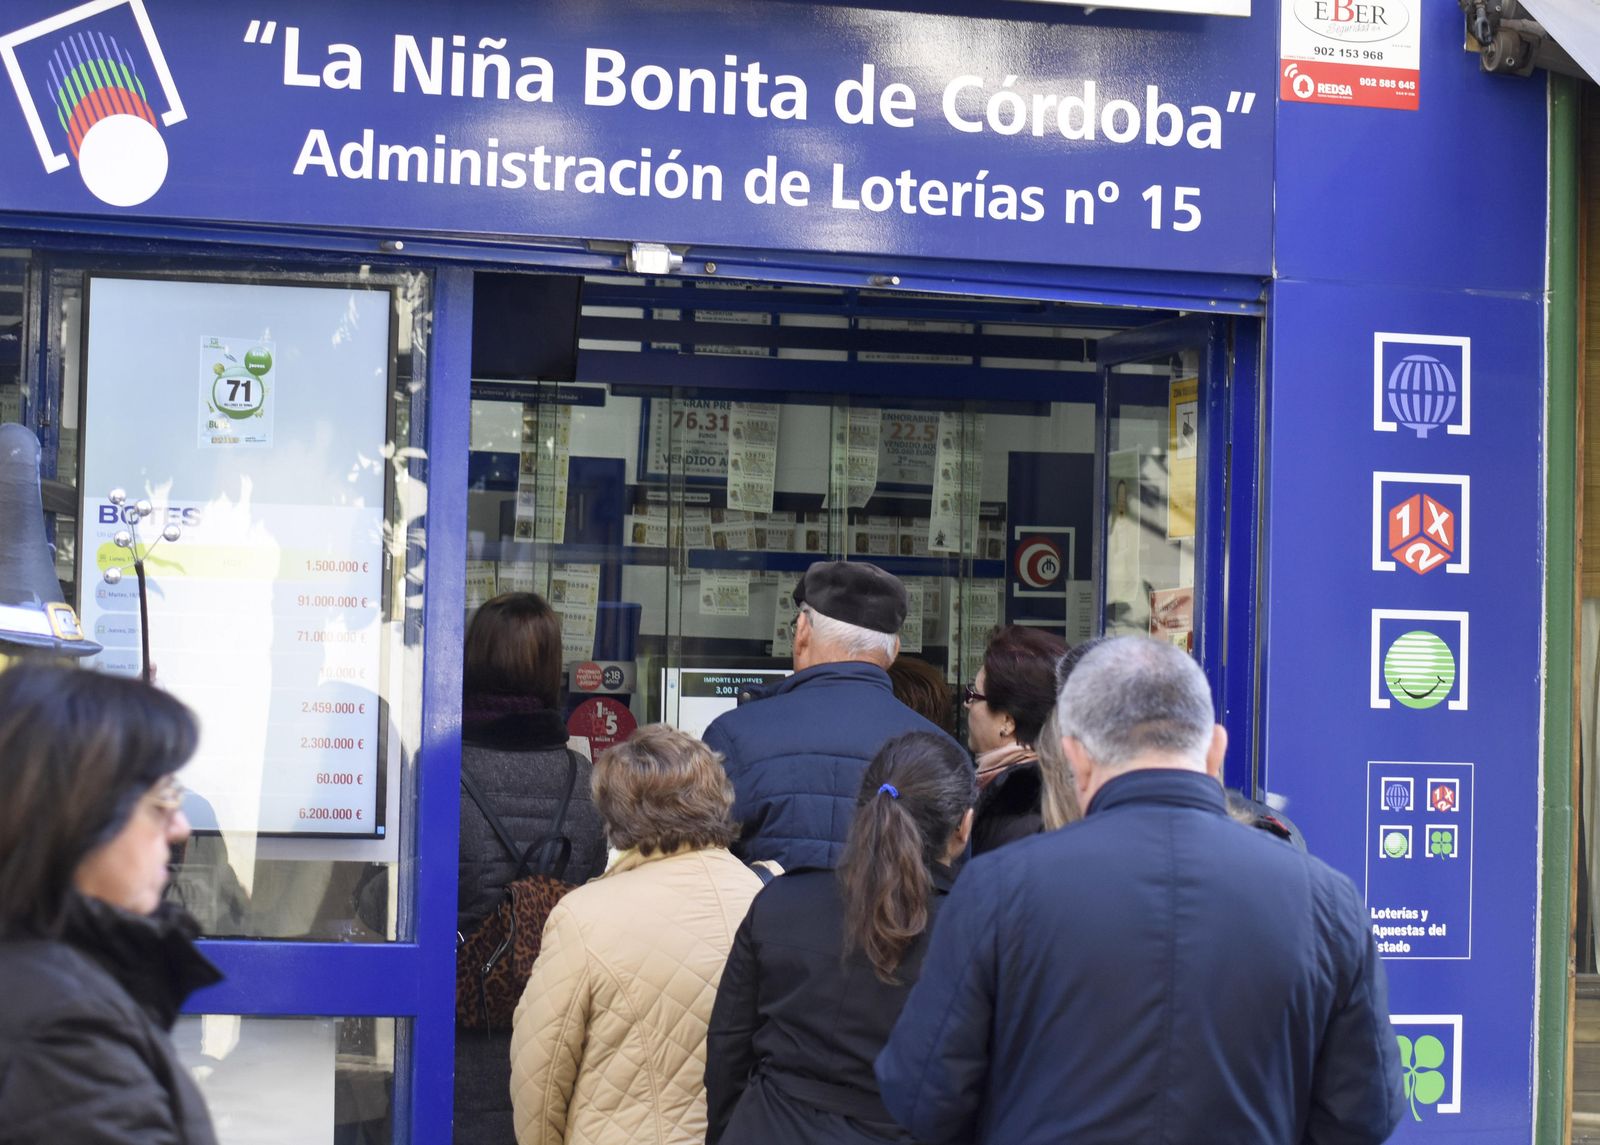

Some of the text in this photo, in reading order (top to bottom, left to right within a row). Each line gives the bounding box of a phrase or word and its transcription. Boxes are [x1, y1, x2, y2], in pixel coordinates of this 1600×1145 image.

[1314, 0, 1388, 25] EBER
[1314, 46, 1383, 60] 902 153 968
[394, 33, 554, 102] Niña
[584, 47, 808, 120] Bonita
[835, 64, 916, 127] de
[1360, 77, 1376, 87] 902
[1317, 83, 1352, 96] REDSA
[293, 129, 722, 201] Administración
[744, 156, 810, 207] de
[832, 163, 1045, 222] Loterías
[1142, 185, 1201, 231] 15
[226, 379, 251, 402] 71
[683, 399, 710, 409] GRAN
[663, 454, 728, 466] VENDIDO A
[99, 505, 201, 526] BOTES
[305, 560, 368, 573] 1.500.000 €
[297, 595, 367, 608] 91.000.000 €
[604, 670, 620, 680] +18
[703, 676, 731, 684] IMPORTE
[716, 686, 732, 694] 3,00
[302, 702, 365, 714] 2.459.000 €
[606, 714, 618, 736] 5
[301, 737, 364, 749] 2.300.000 €
[317, 773, 363, 785] 60.000 €
[299, 808, 362, 820] 6.200.000 €
[1371, 906, 1428, 922] Loterías y
[1372, 923, 1446, 938] Apuestas del
[1376, 940, 1410, 953] stado
